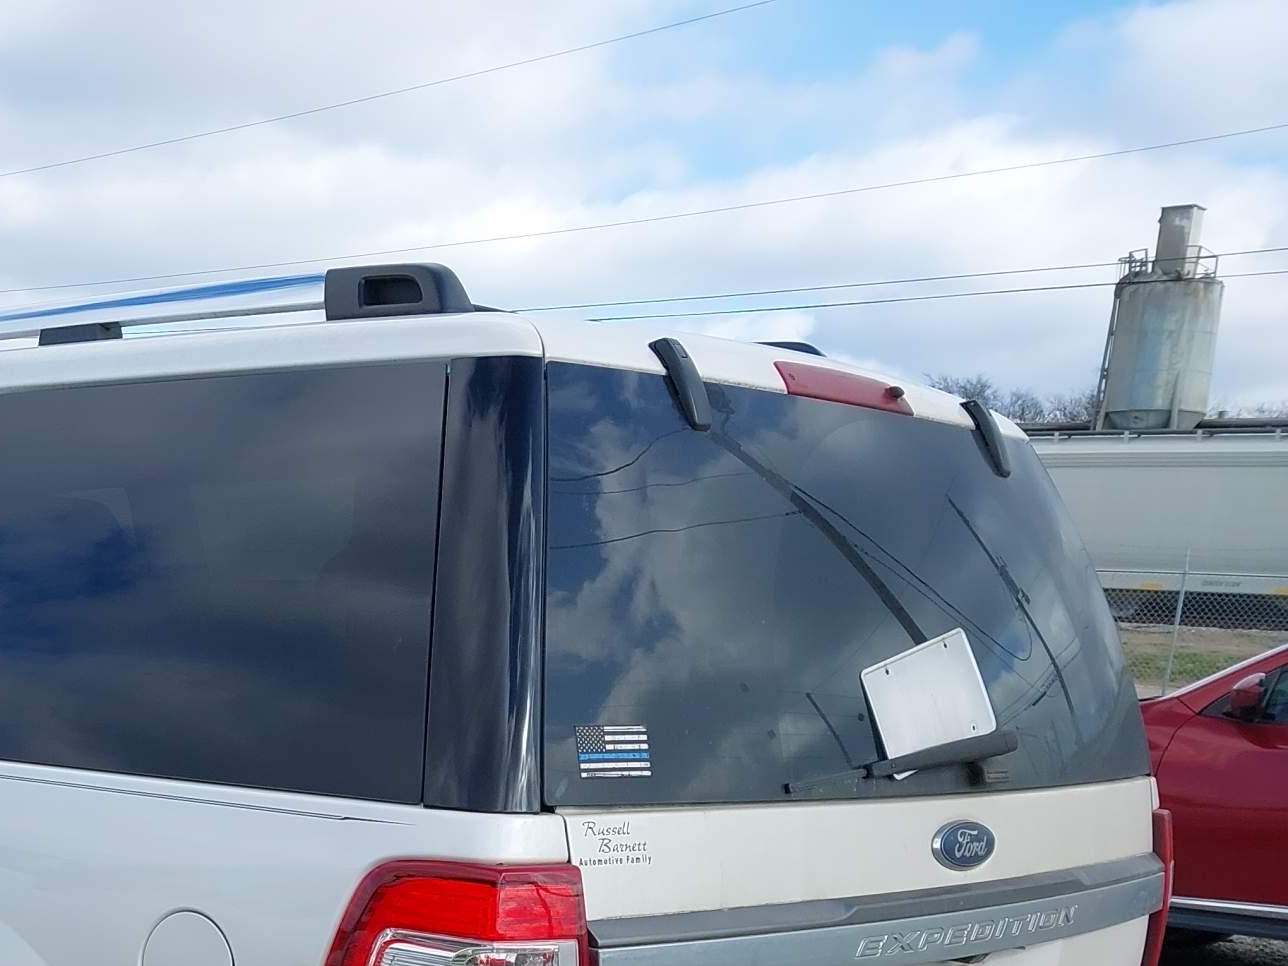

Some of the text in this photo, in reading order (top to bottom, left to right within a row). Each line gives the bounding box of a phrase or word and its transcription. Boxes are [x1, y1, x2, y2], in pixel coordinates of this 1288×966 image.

[582, 821, 630, 837] Russell
[598, 837, 647, 853] Barnett
[954, 829, 988, 858] Ford
[578, 854, 652, 866] Automotive Family
[855, 904, 1079, 960] EXPEDITION
